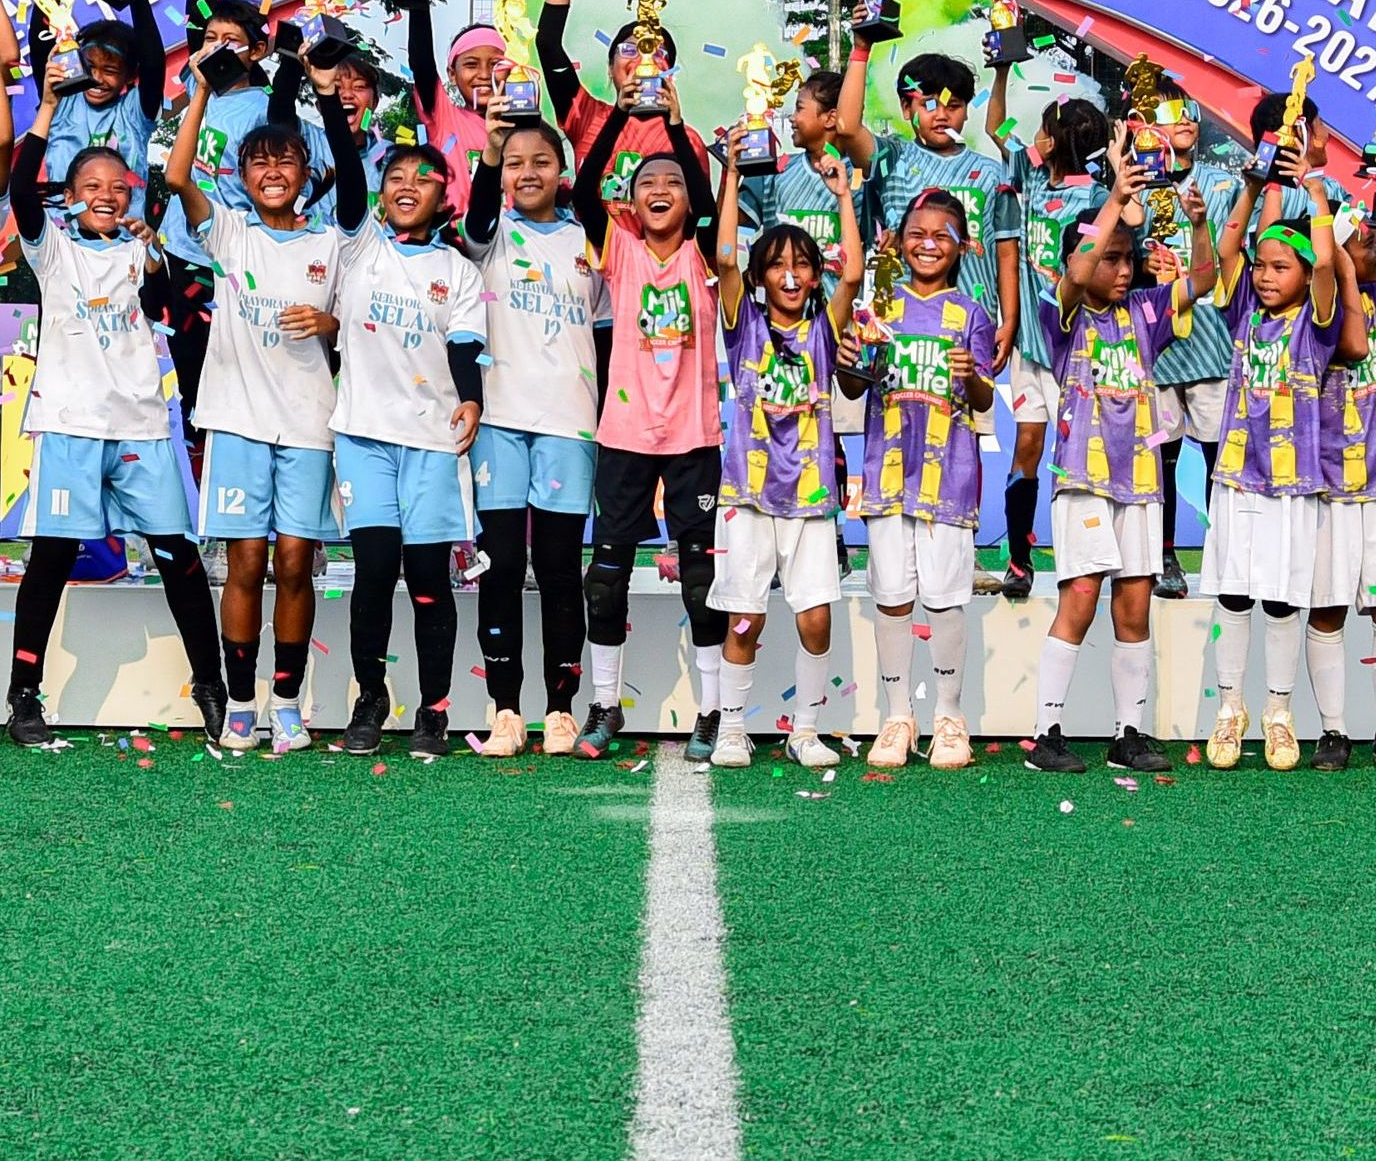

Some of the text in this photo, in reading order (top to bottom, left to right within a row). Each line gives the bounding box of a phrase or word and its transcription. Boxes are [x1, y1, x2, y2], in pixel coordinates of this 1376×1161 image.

[263, 330, 280, 349] 19
[403, 332, 422, 349] 19
[894, 340, 948, 371] Milk
[902, 366, 948, 395] Life
[475, 461, 491, 487] 4
[50, 488, 70, 516] 11
[217, 487, 246, 516] 12
